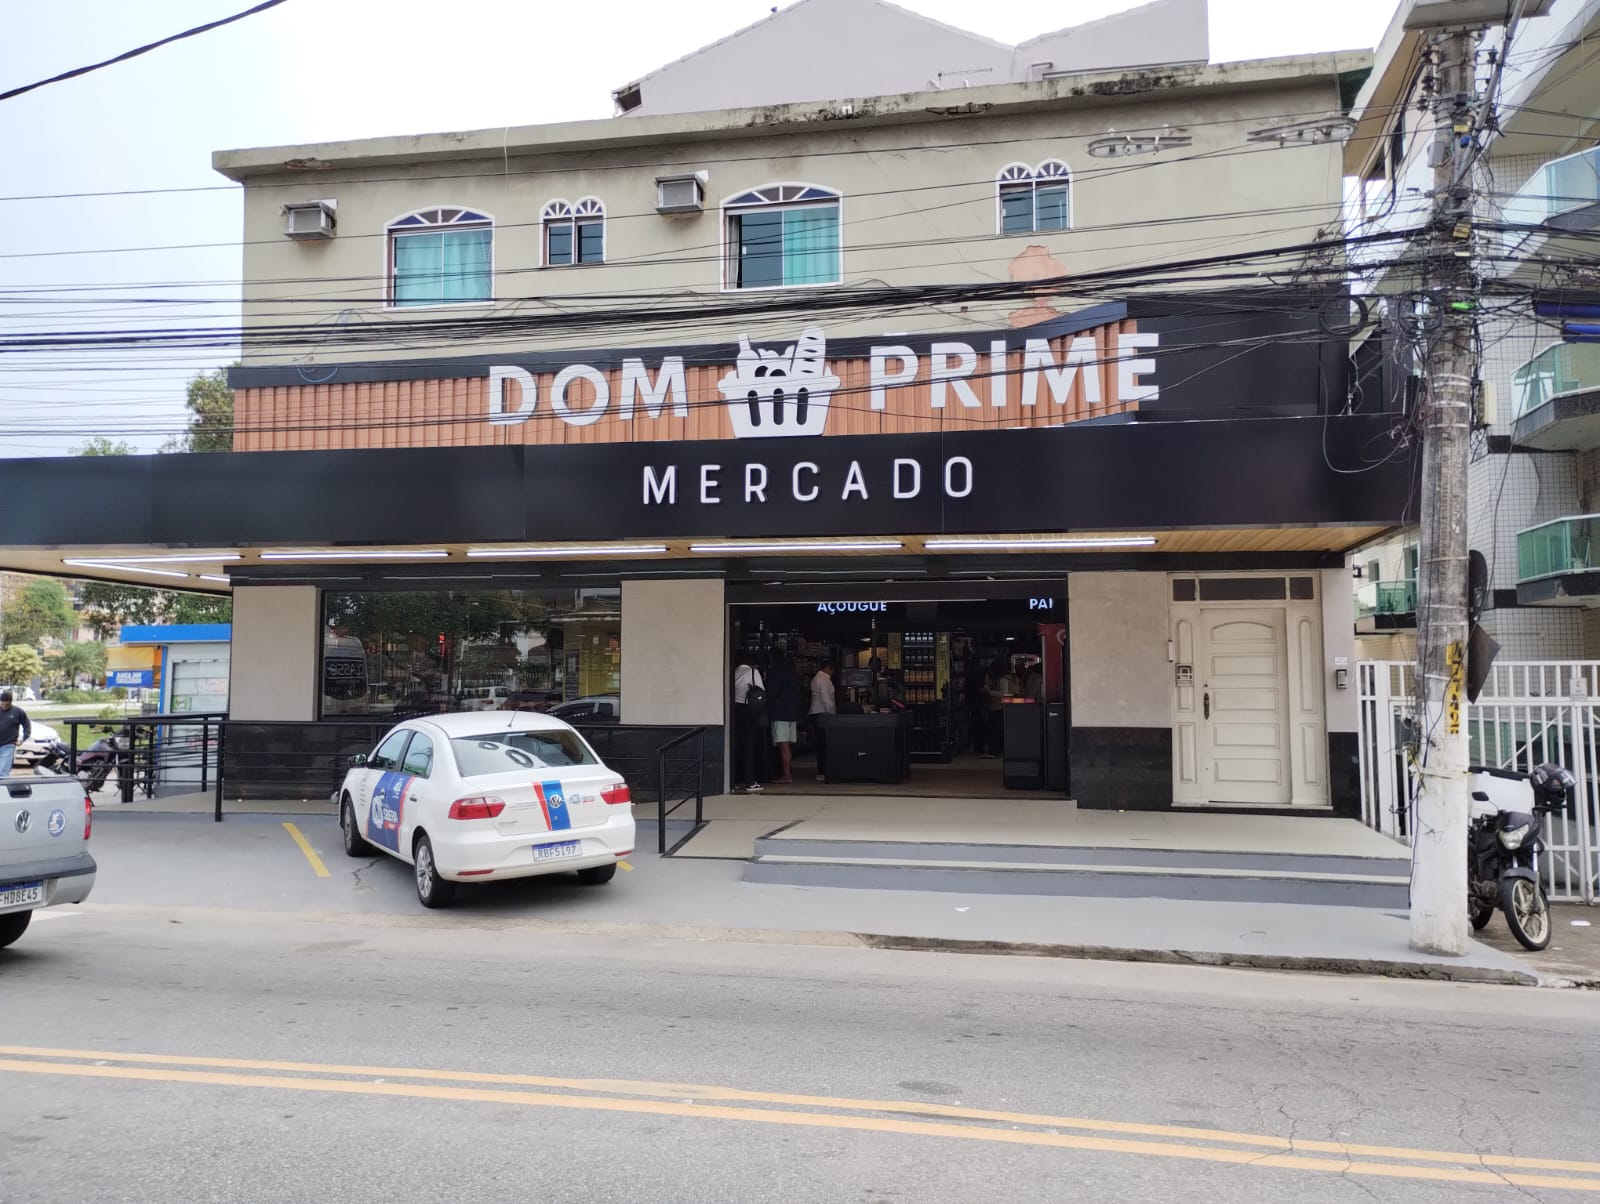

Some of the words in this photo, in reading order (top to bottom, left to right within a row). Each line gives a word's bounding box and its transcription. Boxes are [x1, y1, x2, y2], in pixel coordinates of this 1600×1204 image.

[489, 356, 688, 426] DOM
[870, 333, 1159, 409] PRIME
[643, 456, 973, 504] MERCADO
[817, 600, 887, 615] AÇOUGUE
